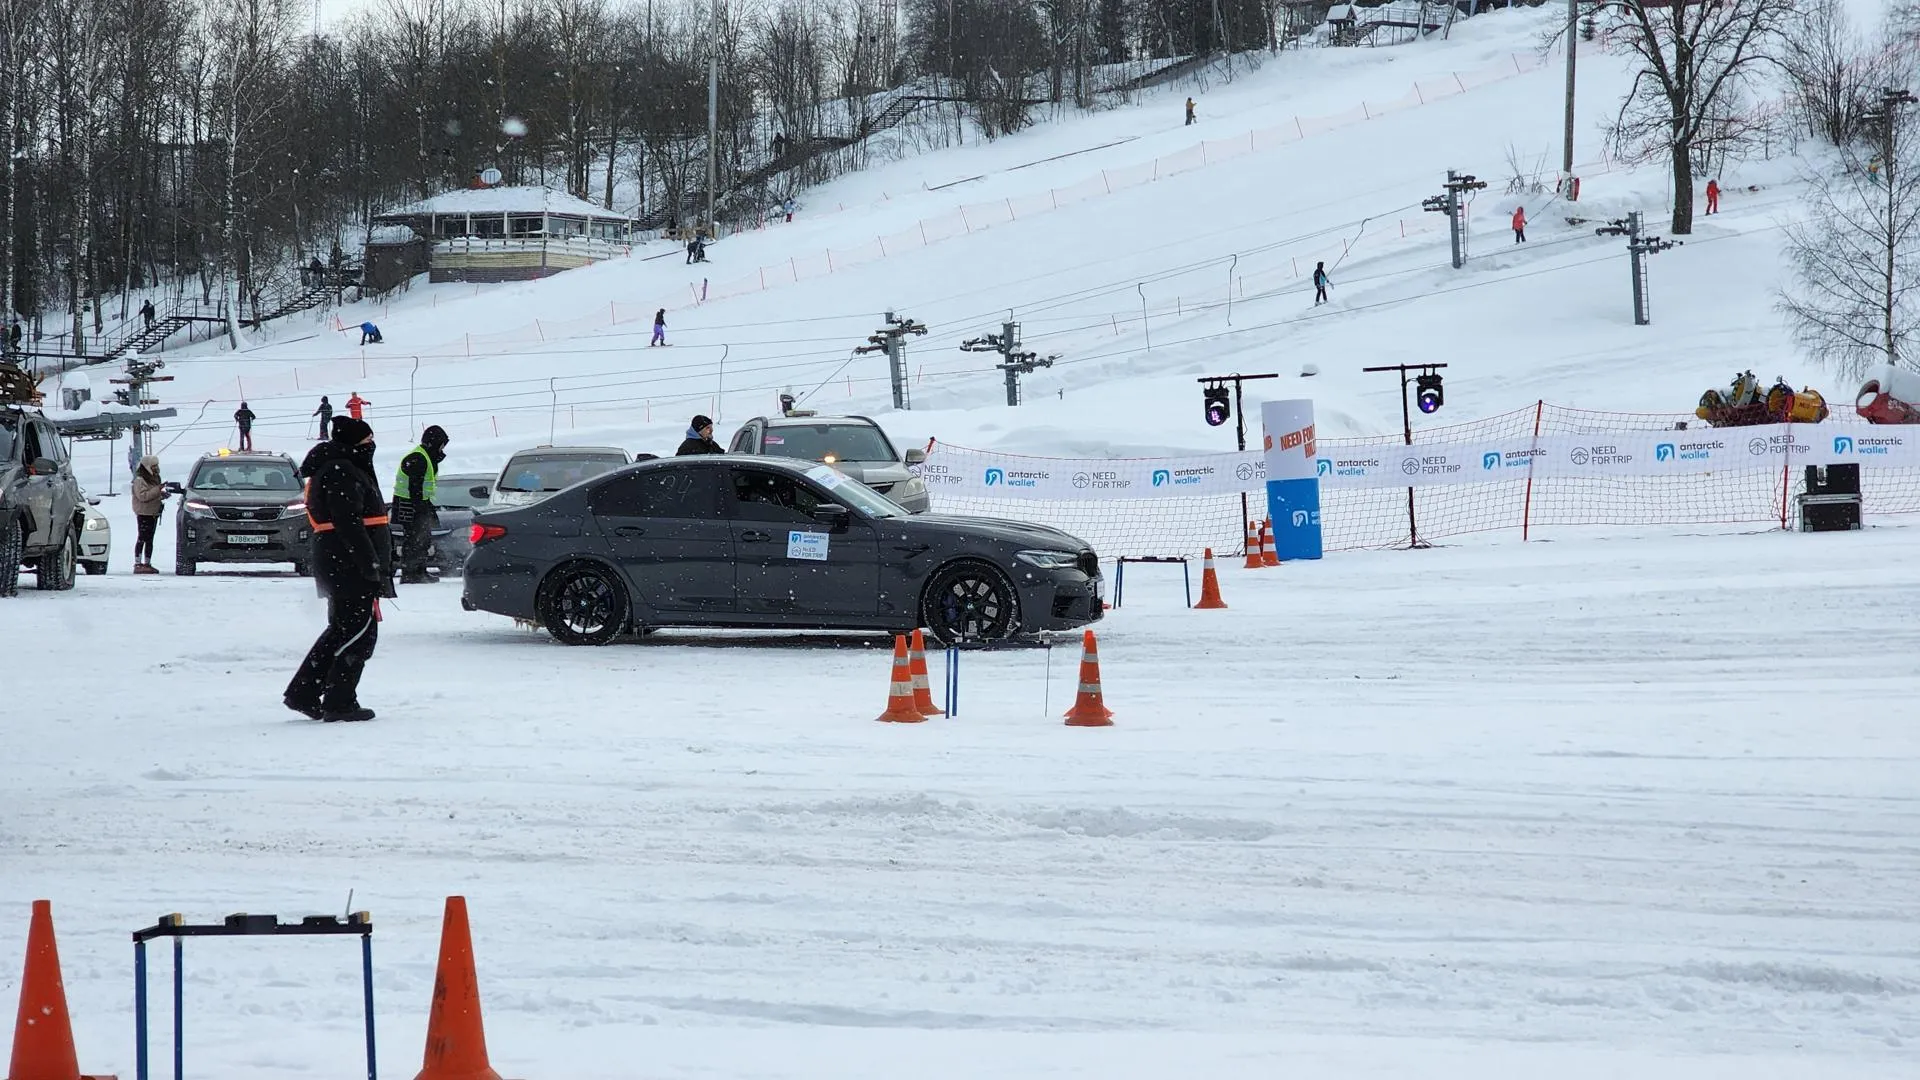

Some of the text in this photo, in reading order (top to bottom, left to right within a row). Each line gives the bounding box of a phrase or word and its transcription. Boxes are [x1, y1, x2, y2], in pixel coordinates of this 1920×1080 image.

[1280, 431, 1302, 451] NEED
[1769, 435, 1795, 444] NEED
[1858, 436, 1903, 445] antarctic
[1680, 440, 1724, 450] antarctic
[1769, 444, 1811, 454] FOR TRIP
[1505, 447, 1547, 459] antarctic
[1591, 446, 1617, 455] NEED
[1858, 446, 1888, 454] wallet
[1591, 455, 1633, 464] FOR TRIP
[1680, 450, 1710, 460] wallet
[1336, 458, 1379, 467] antarctic
[1422, 456, 1446, 465] NEED
[1505, 458, 1533, 467] wallet
[924, 464, 948, 474] NEED
[1255, 461, 1266, 470] NE
[1422, 464, 1461, 474] FOR TRIP
[1007, 471, 1050, 480] antarctic
[1092, 472, 1117, 480] NEED
[1174, 466, 1215, 477] antarctic
[1255, 471, 1266, 479] FO
[1336, 467, 1365, 476] wallet
[924, 474, 963, 484] FOR TRIP
[1007, 479, 1036, 488] wallet
[1174, 475, 1201, 485] wallet
[655, 475, 693, 502] 24
[1092, 480, 1131, 489] FOR TRIP
